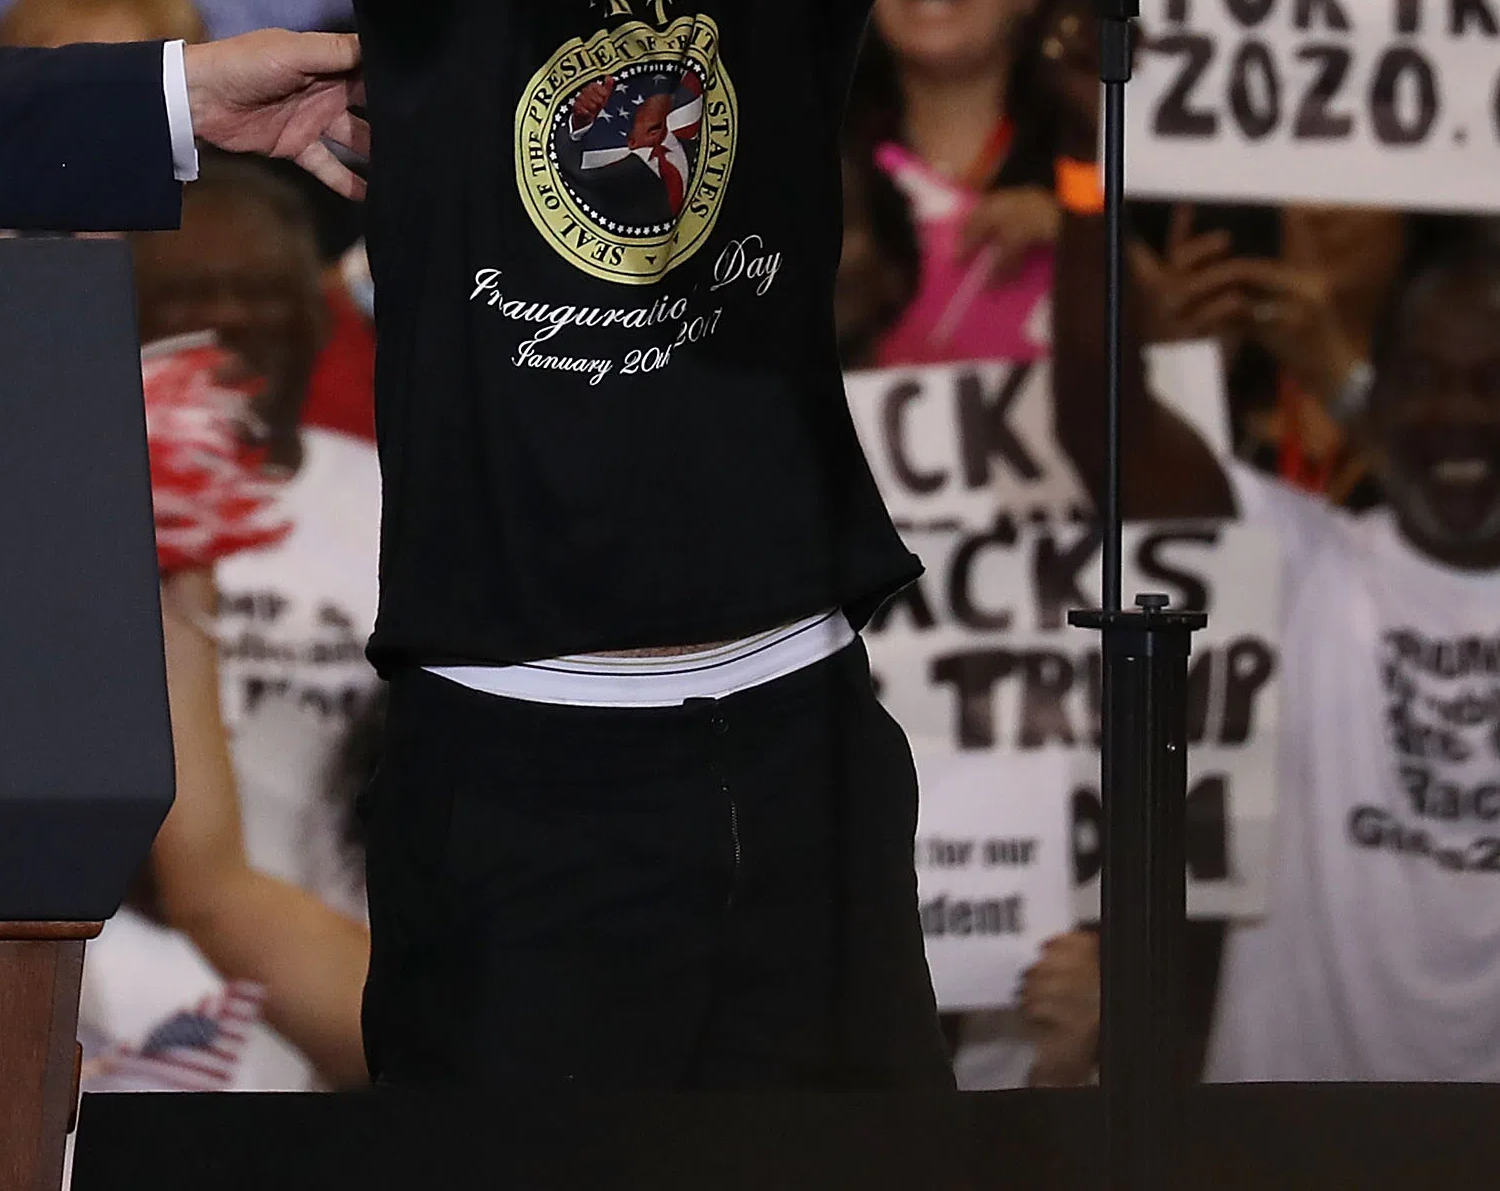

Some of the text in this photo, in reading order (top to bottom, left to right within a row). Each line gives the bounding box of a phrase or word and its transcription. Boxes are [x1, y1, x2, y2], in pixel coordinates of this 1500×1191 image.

[1143, 31, 1500, 147] 2020.
[691, 101, 730, 218] STATES
[538, 184, 560, 210] OF
[560, 214, 625, 266] SEAL
[710, 235, 782, 296] Day
[511, 307, 723, 386] January 20th 2017
[880, 366, 1044, 495] CK
[919, 891, 1027, 938] dent
